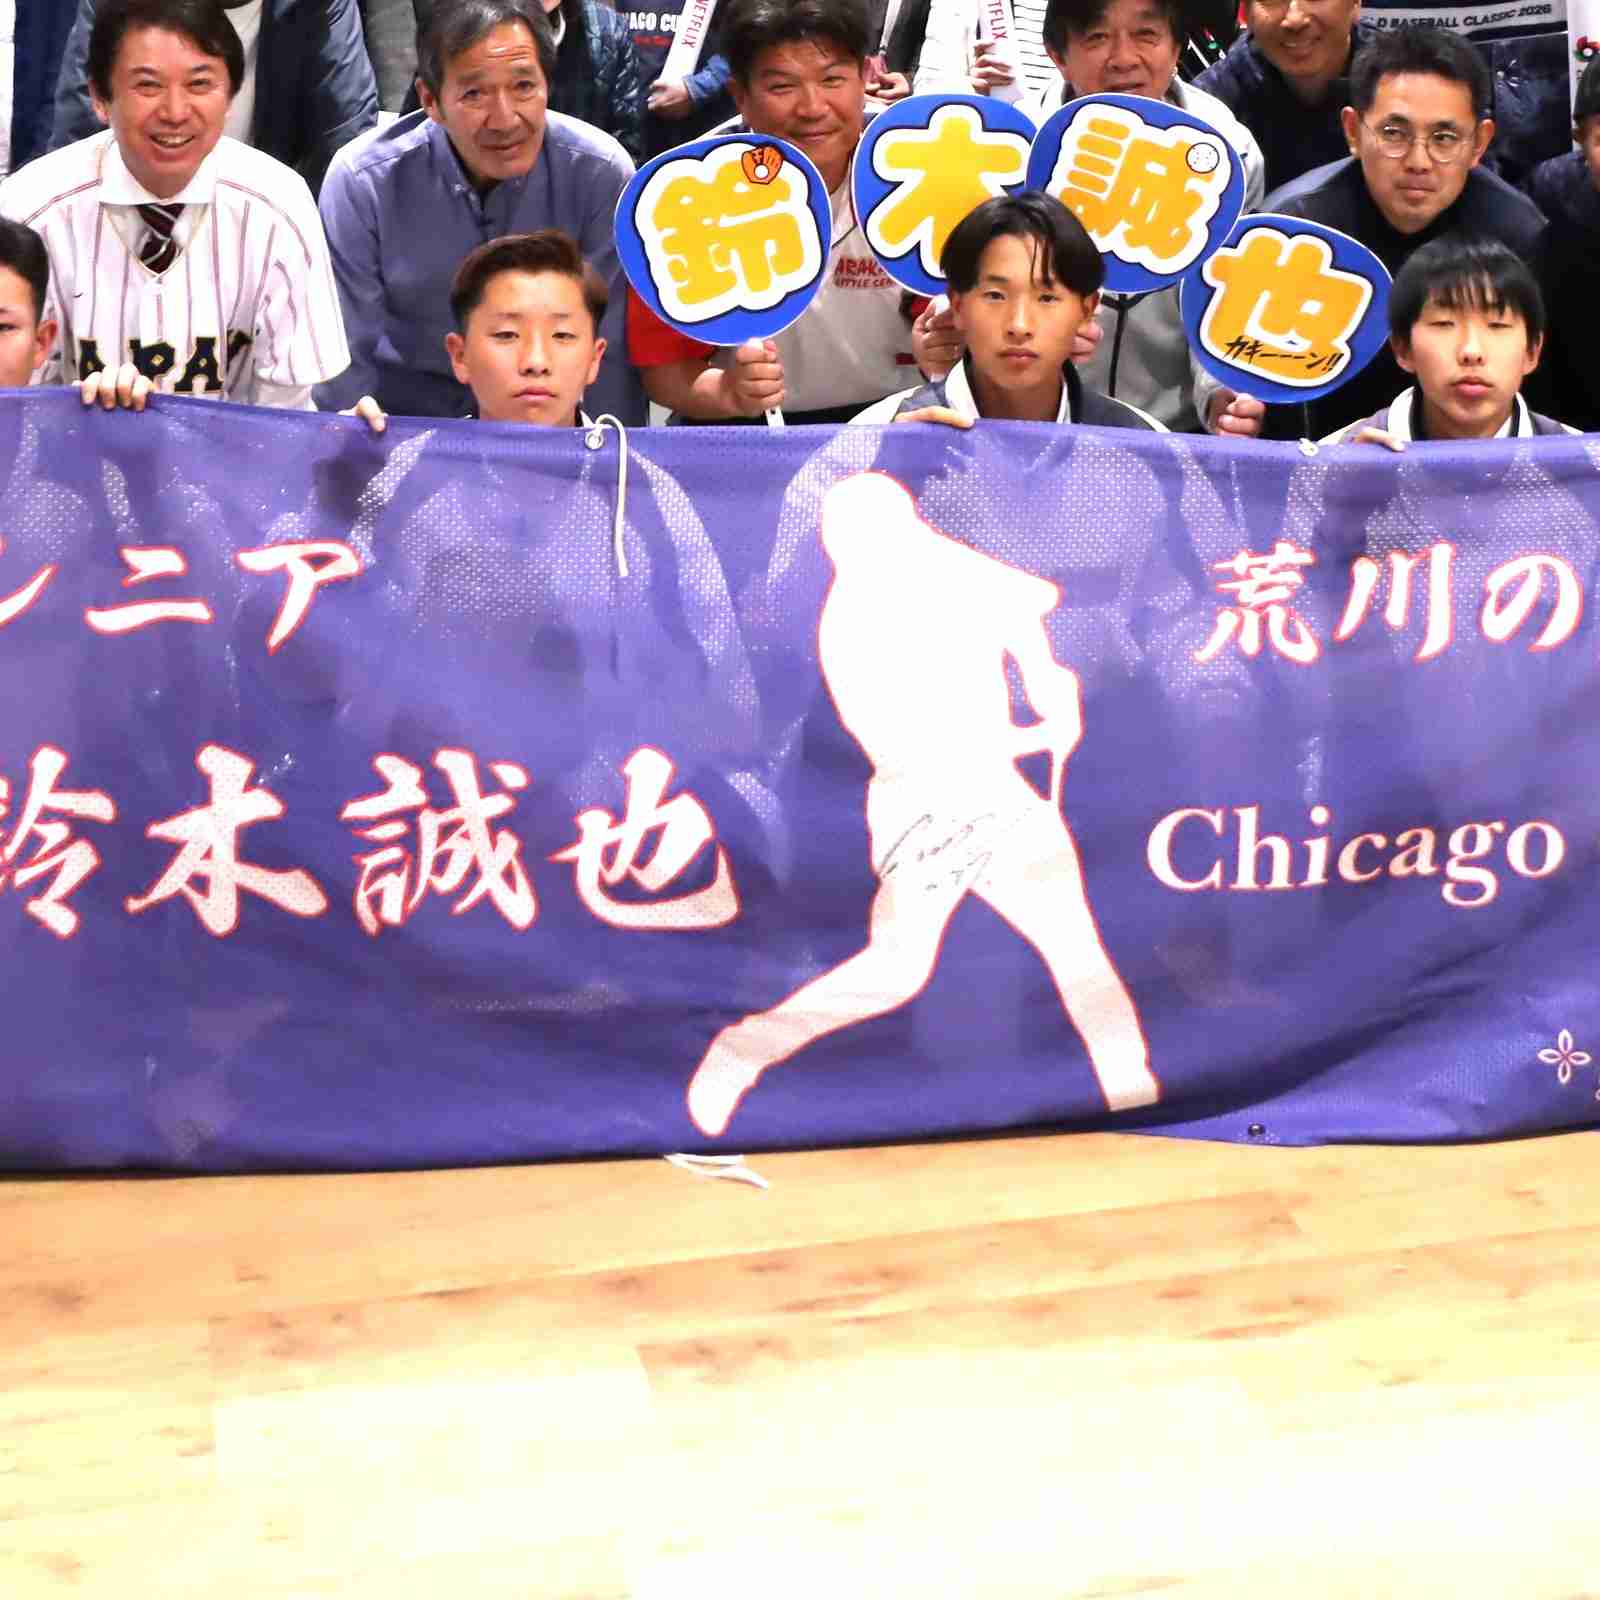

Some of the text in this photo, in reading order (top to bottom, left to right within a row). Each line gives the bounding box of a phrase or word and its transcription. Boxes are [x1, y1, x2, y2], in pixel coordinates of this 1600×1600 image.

[1391, 12, 1458, 30] BASEBALL
[1462, 8, 1516, 27] CLASSIC
[1517, 2, 1552, 18] 2026
[651, 156, 806, 303] 鈴
[879, 117, 1030, 276] 木
[1060, 116, 1221, 262] 誠
[833, 257, 885, 277] ARAK
[1210, 233, 1368, 367] 也
[1145, 803, 1566, 911] Chicago
